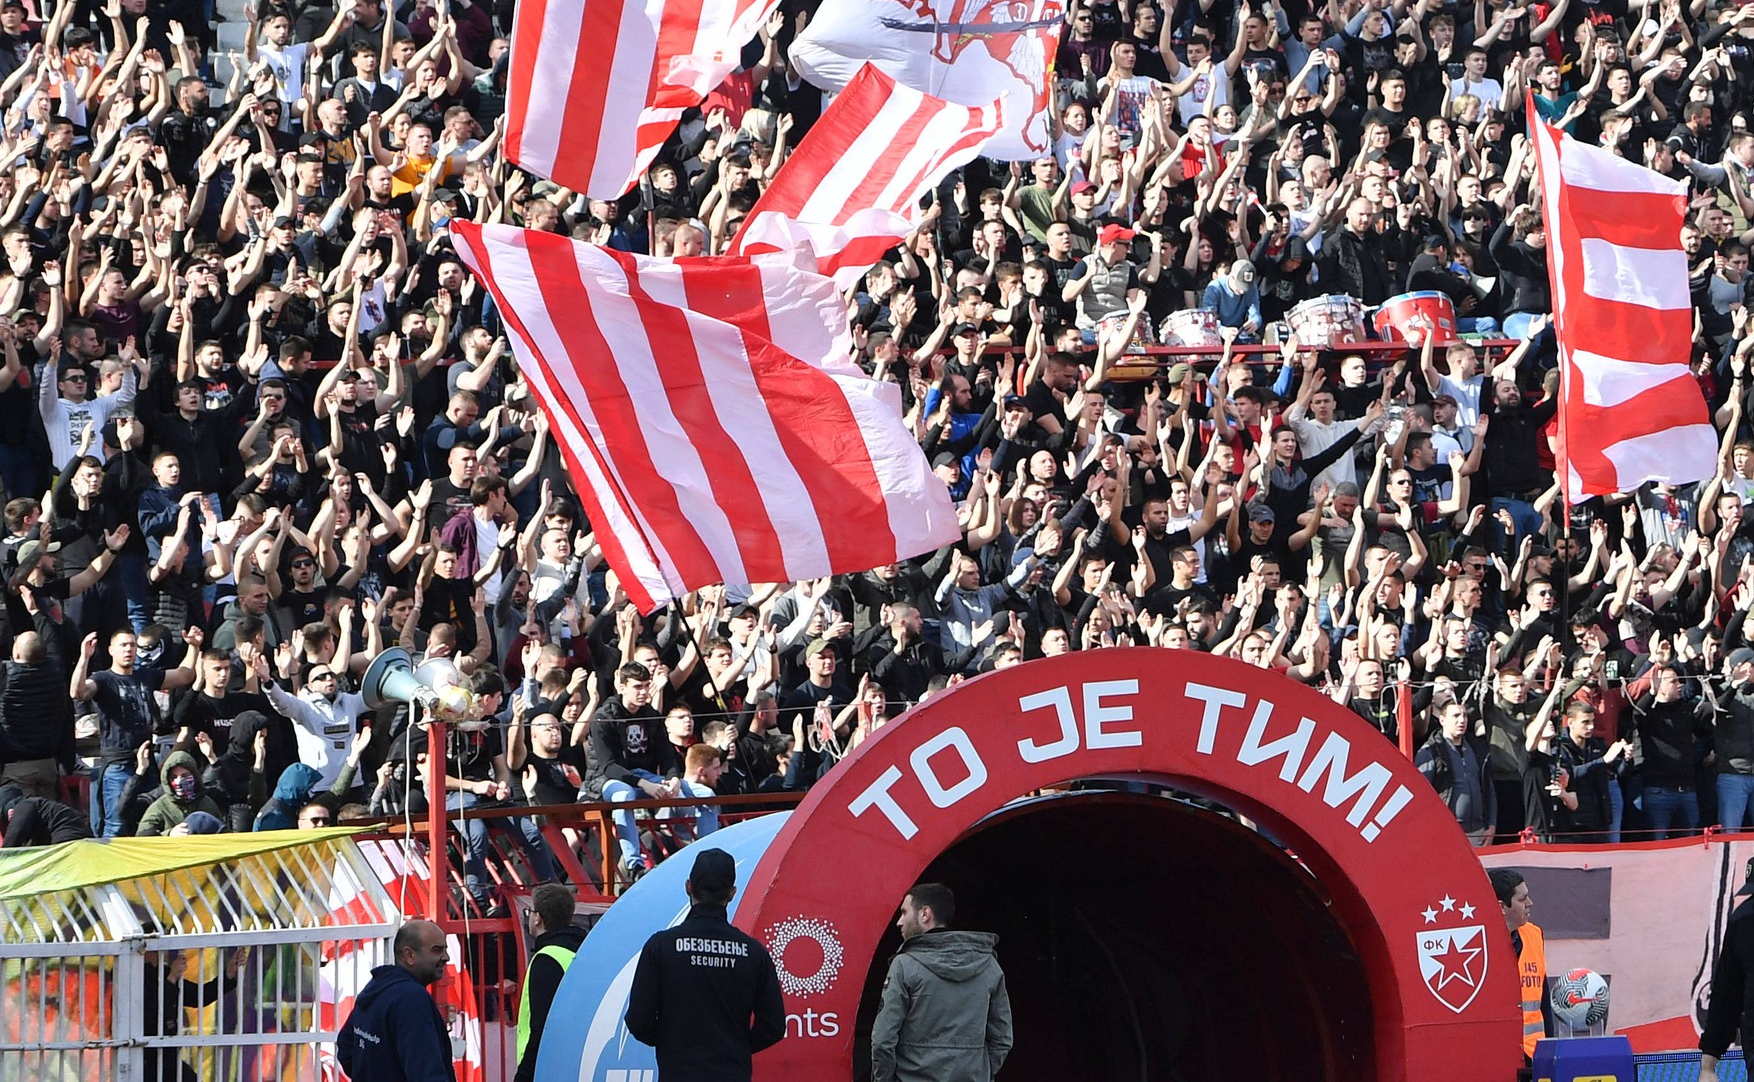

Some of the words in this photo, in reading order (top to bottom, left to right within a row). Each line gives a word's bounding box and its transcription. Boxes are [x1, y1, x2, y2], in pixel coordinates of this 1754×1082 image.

[1184, 681, 1414, 844] ТИМ!
[676, 937, 748, 957] ОБЕЗБЕЂЕЊЕ
[1423, 939, 1444, 950] ФК
[690, 955, 736, 968] SECURITY
[1521, 975, 1541, 988] FOTO
